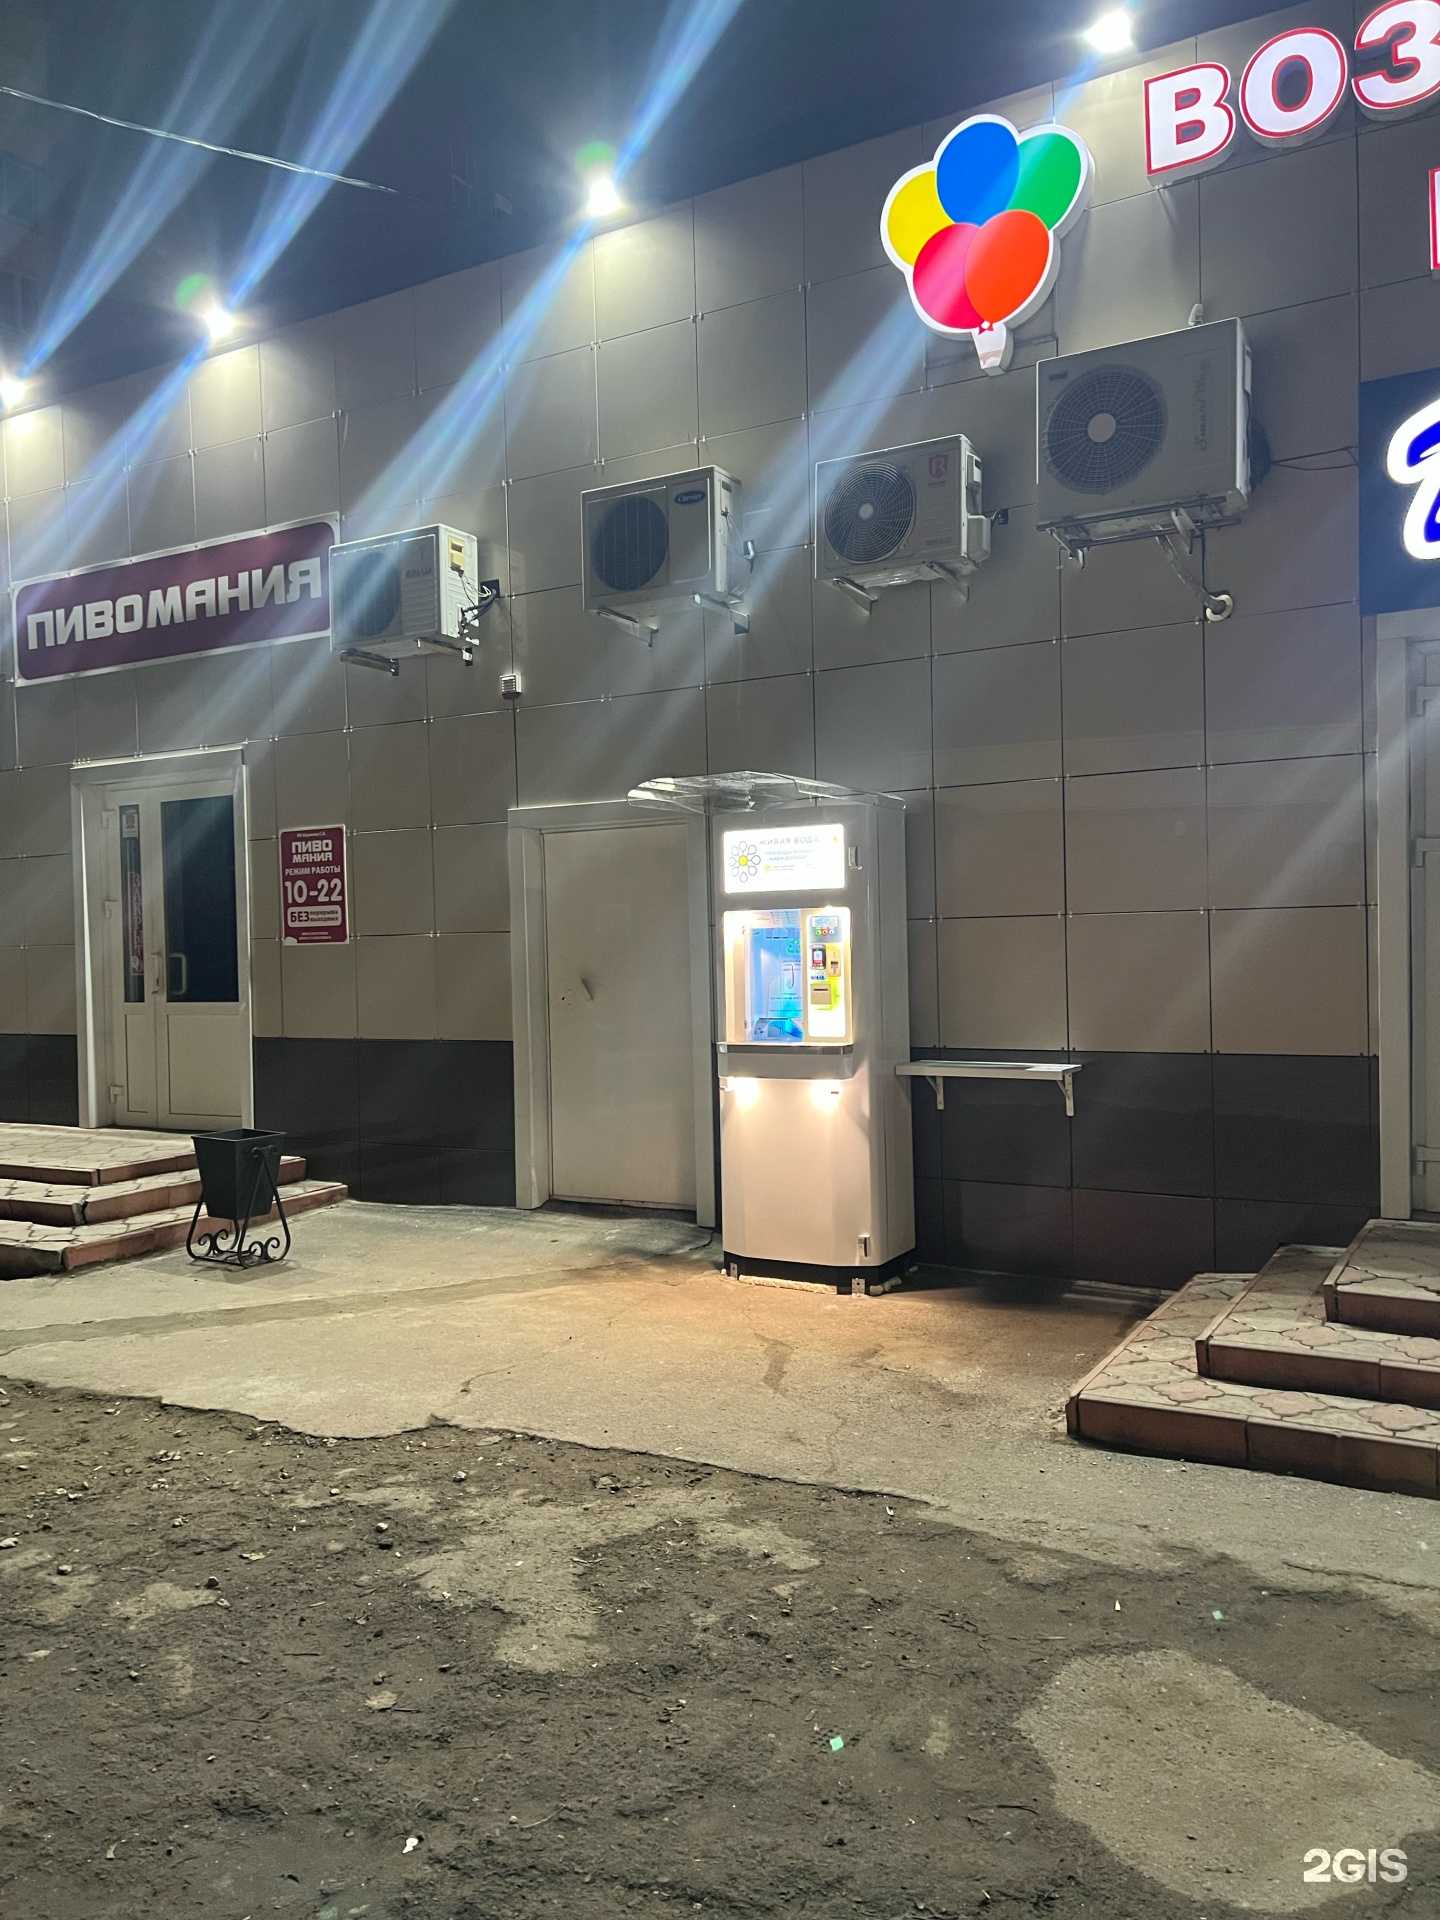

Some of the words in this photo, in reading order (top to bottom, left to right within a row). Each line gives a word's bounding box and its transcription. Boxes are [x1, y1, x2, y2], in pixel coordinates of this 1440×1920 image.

[26, 557, 322, 650] ПИВОМАНИЯ
[291, 839, 333, 853] ПИВО
[292, 852, 333, 863] МАНИЯ
[311, 865, 341, 874] РАБОТЫ
[284, 877, 343, 904] 10-22
[290, 911, 310, 923] БЕЗ
